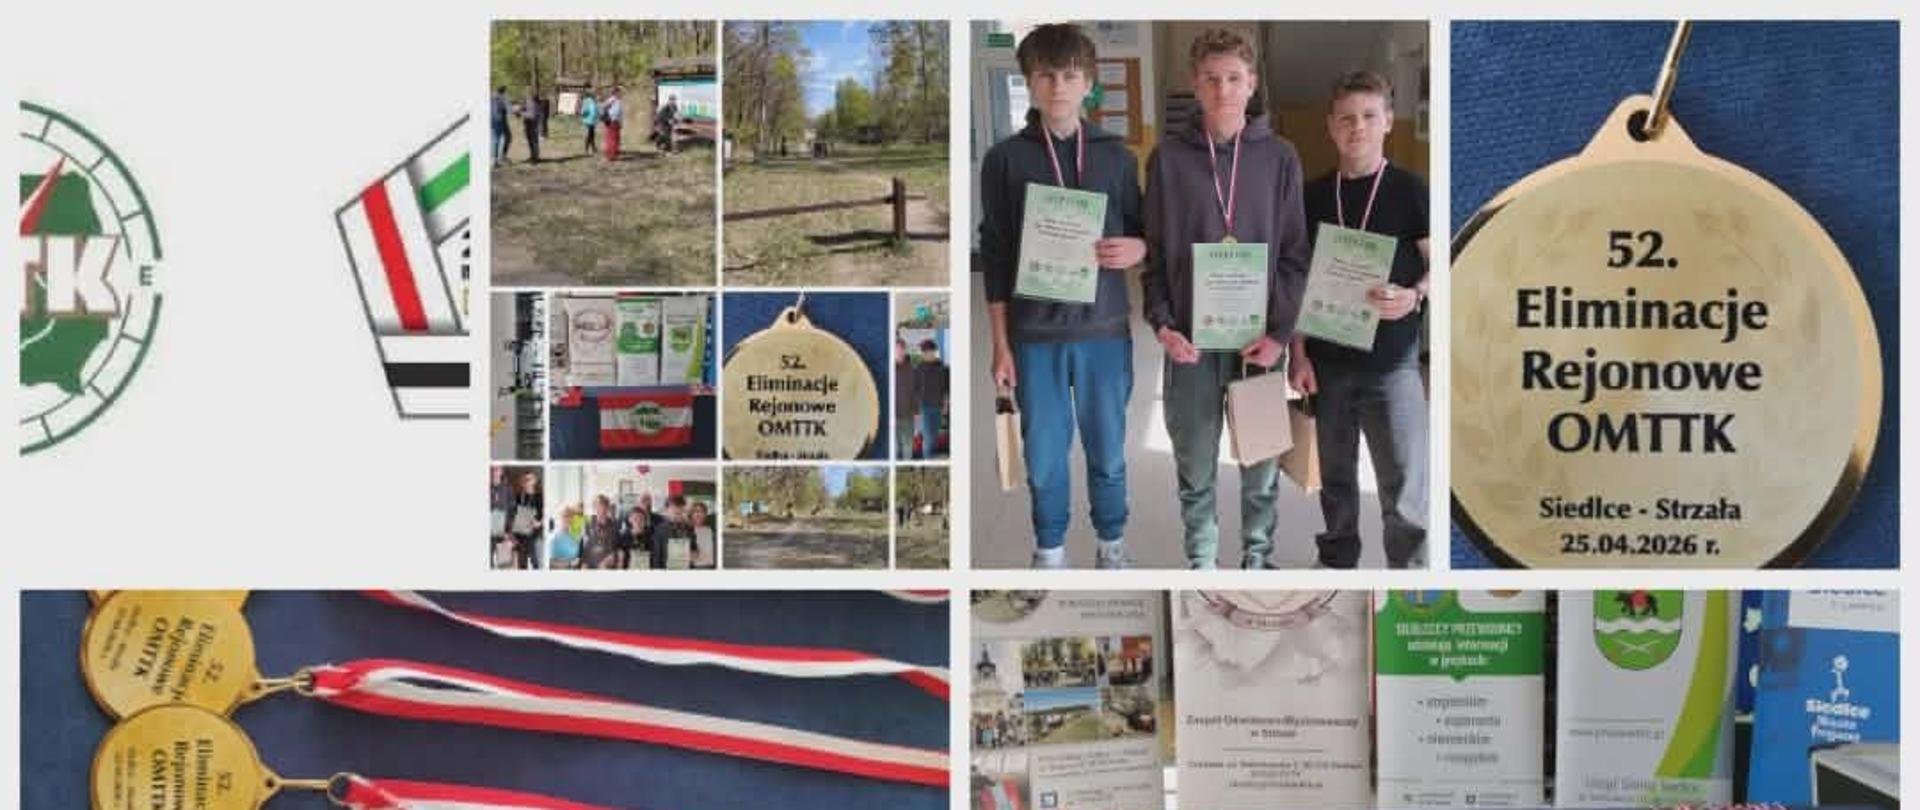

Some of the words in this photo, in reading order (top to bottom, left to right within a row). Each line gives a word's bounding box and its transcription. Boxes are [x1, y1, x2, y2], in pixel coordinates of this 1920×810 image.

[1606, 230, 1679, 269] 52.
[139, 264, 152, 287] E
[1516, 285, 1769, 344] Eliminacje
[746, 374, 840, 396] Eliminacje
[1521, 347, 1763, 404] Rejonowe
[748, 396, 837, 417] Rejonowe
[757, 419, 827, 437] OMTTK
[1546, 412, 1737, 454] OMTTK
[1539, 496, 1632, 521] Siedlce
[1655, 497, 1742, 521] Strzała
[1561, 533, 1697, 556] 25.04.2026
[1705, 540, 1721, 556] r.
